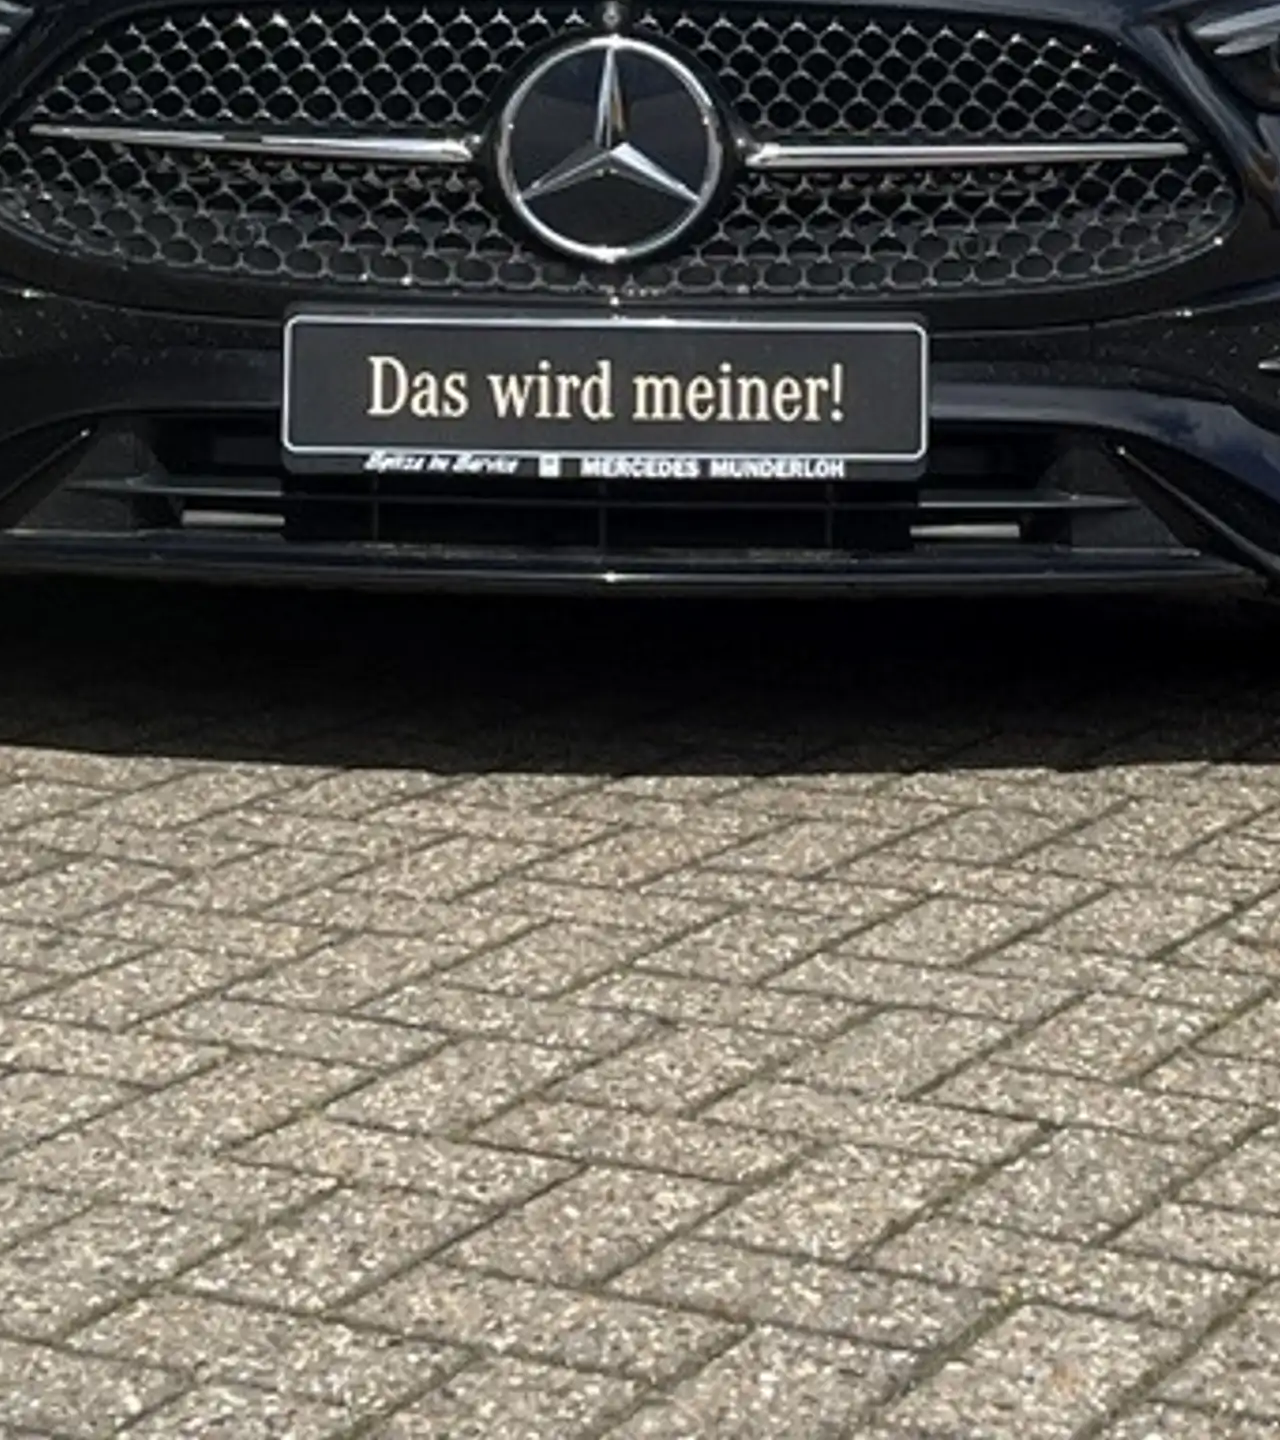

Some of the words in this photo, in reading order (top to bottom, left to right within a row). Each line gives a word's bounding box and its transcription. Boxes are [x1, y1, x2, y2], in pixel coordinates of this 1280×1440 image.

[367, 355, 469, 418] Das
[487, 359, 615, 420] wird
[632, 362, 844, 422] meiner!
[580, 458, 700, 478] MERCEDES
